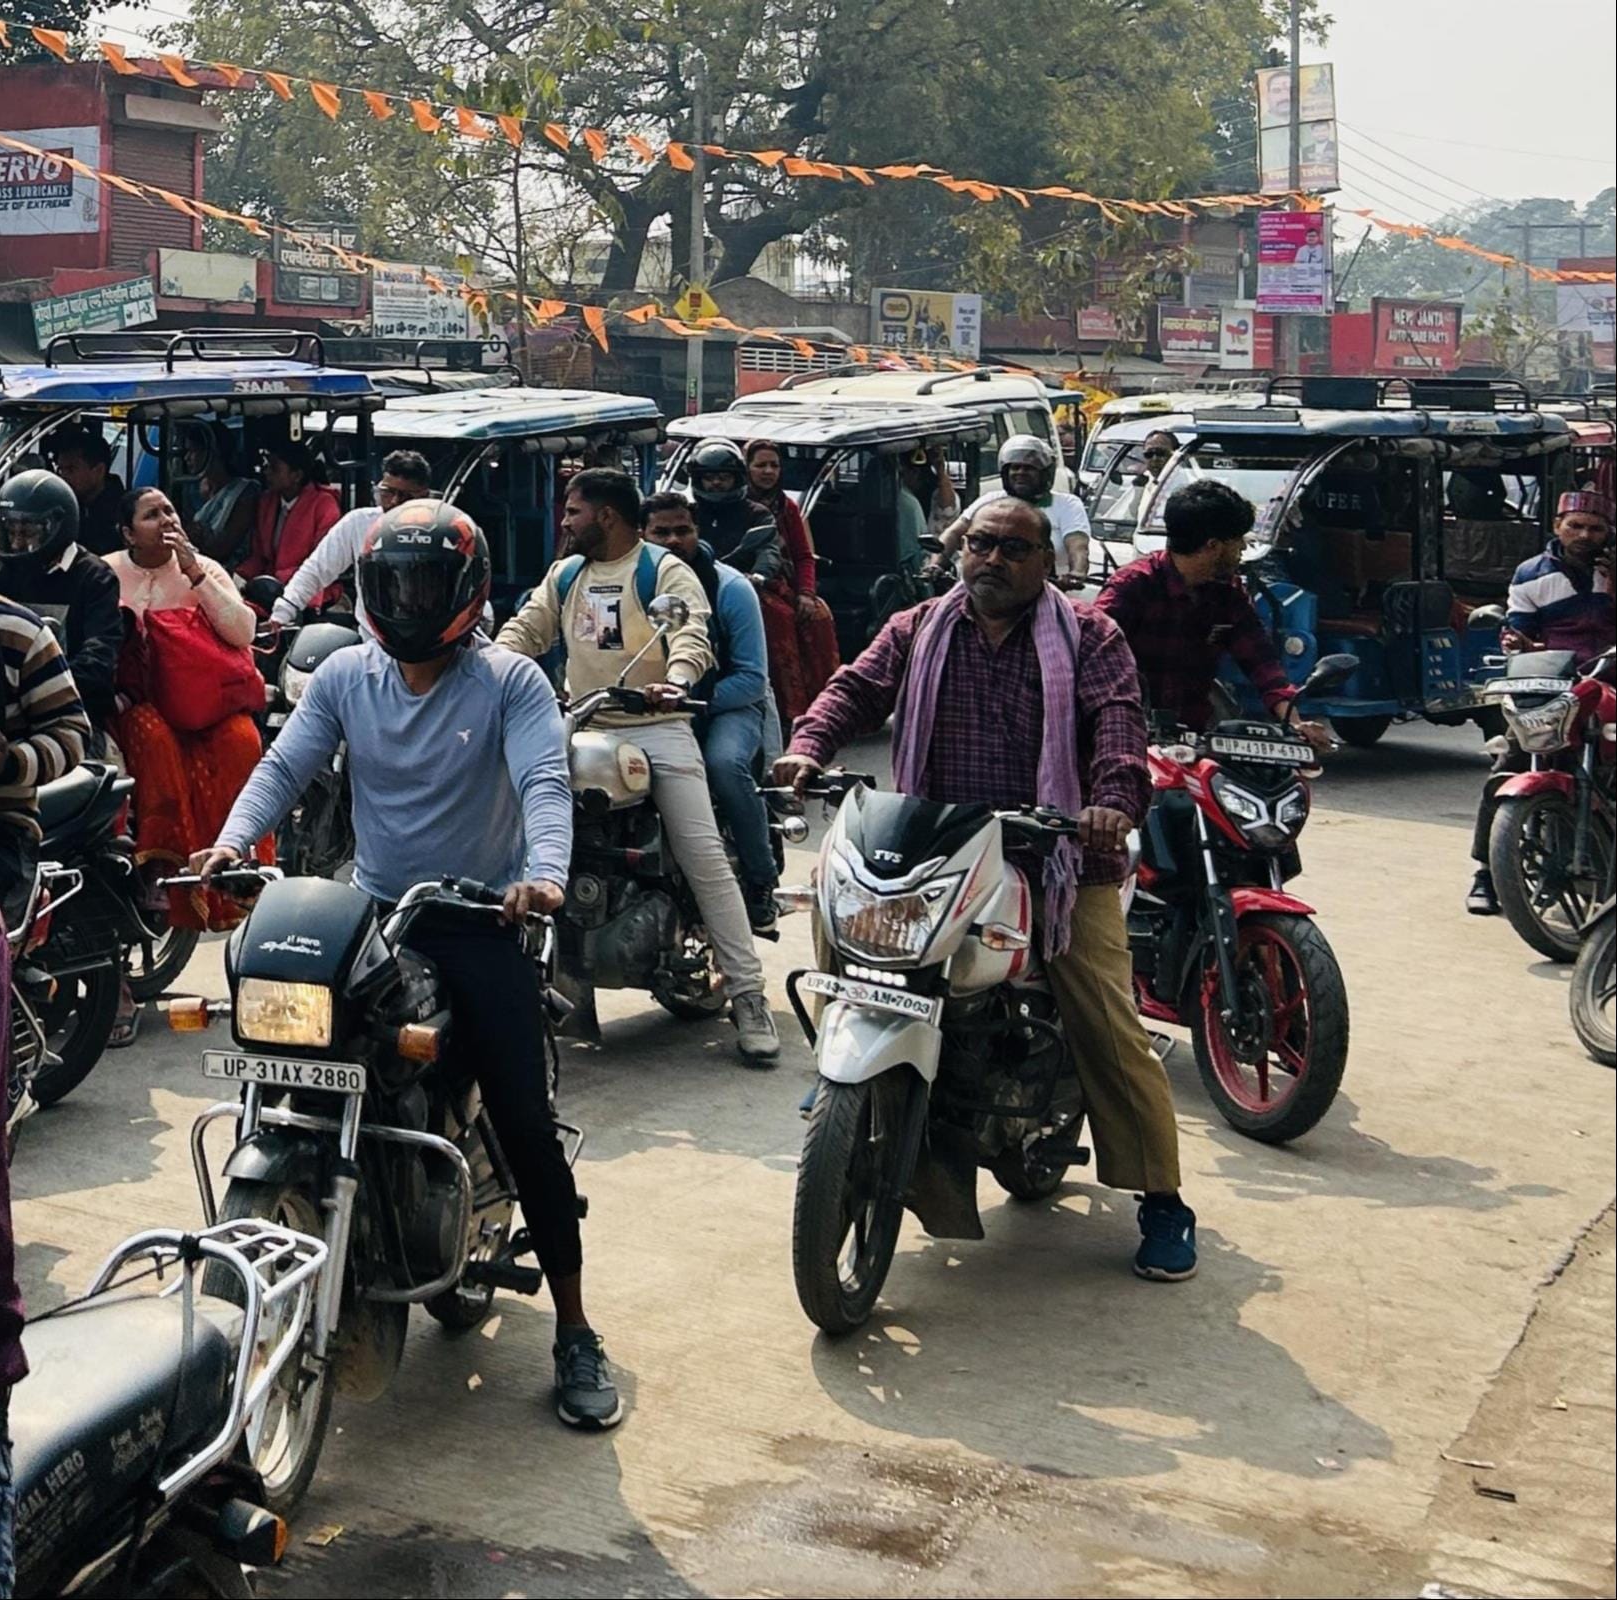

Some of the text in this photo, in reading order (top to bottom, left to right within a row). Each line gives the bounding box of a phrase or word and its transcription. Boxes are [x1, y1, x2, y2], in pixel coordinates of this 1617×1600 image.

[15, 184, 70, 199] LUBRICANTS
[11, 201, 25, 210] OF
[26, 199, 71, 210] EXTREME
[1246, 725, 1269, 736] TVS
[872, 849, 903, 865] TVS
[223, 1058, 361, 1091] UP 31AX 2880
[44, 1449, 85, 1497] HERO
